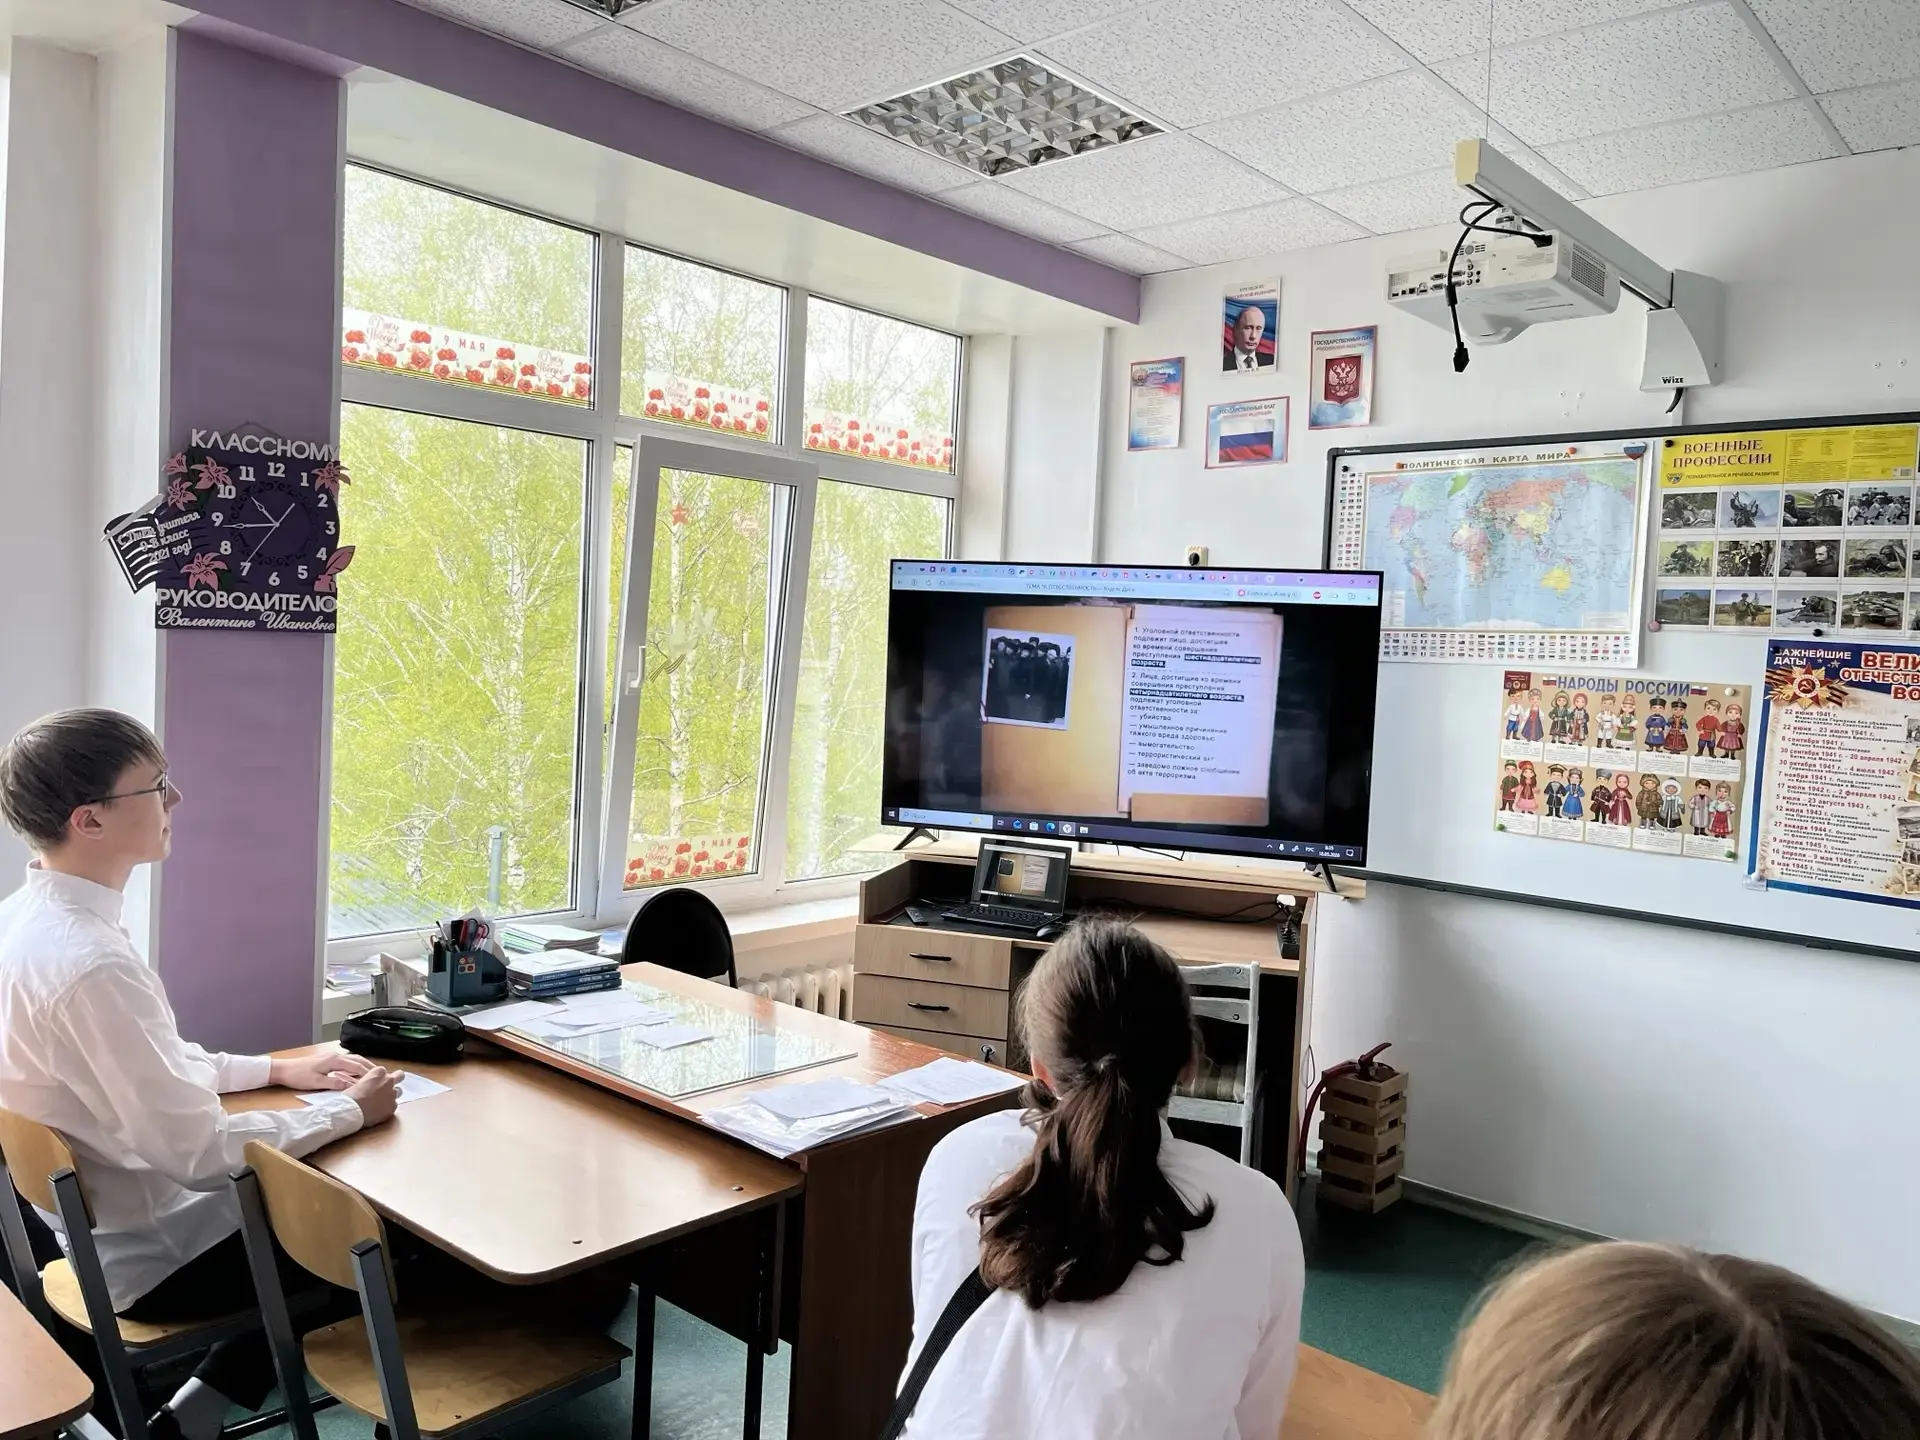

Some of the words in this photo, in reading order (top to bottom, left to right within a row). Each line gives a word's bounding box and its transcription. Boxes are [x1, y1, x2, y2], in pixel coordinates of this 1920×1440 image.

[444, 335, 449, 345] 9
[459, 338, 485, 352] МАЯ
[191, 428, 340, 462] КЛАССНОМУ
[1684, 440, 1763, 454] ВОЕННЫЕ
[1402, 457, 1485, 469] ПОЛИТИЧЕСКАЯ
[1537, 452, 1571, 461] МИРА
[1673, 453, 1772, 468] ПРОФЕССИИ
[239, 466, 255, 481] 11
[267, 462, 285, 478] 12
[300, 473, 309, 486] 1
[217, 485, 236, 499] 10
[317, 494, 328, 507] 2
[158, 512, 201, 536] учителя
[211, 512, 223, 527] 9
[325, 521, 336, 534] 3
[160, 529, 190, 546] класс
[220, 541, 232, 554] 8
[316, 547, 327, 561] 4
[148, 547, 170, 563] 2021
[240, 562, 252, 576] 7
[297, 565, 308, 579] 5
[268, 572, 280, 586] 6
[156, 588, 338, 613] РУКОВОДИТЕЛЮ
[158, 607, 256, 628] Валентине
[259, 612, 335, 631] Ивановне
[1774, 656, 1806, 665] ДАТЫ
[1558, 676, 1618, 693] НАРОДЫ
[1626, 680, 1690, 696] РОССИИ
[1893, 686, 1920, 701] ВО
[1130, 705, 1188, 713] ответственности
[1140, 712, 1172, 721] убийство
[1138, 742, 1195, 751] вымогательство
[1788, 737, 1820, 745] сентября
[1138, 752, 1201, 761] террористический
[1790, 749, 1819, 757] сентября
[1155, 772, 1196, 780] терроризма
[1845, 790, 1876, 799] февраля
[1819, 799, 1845, 807] августа
[712, 838, 732, 847] МАЯ
